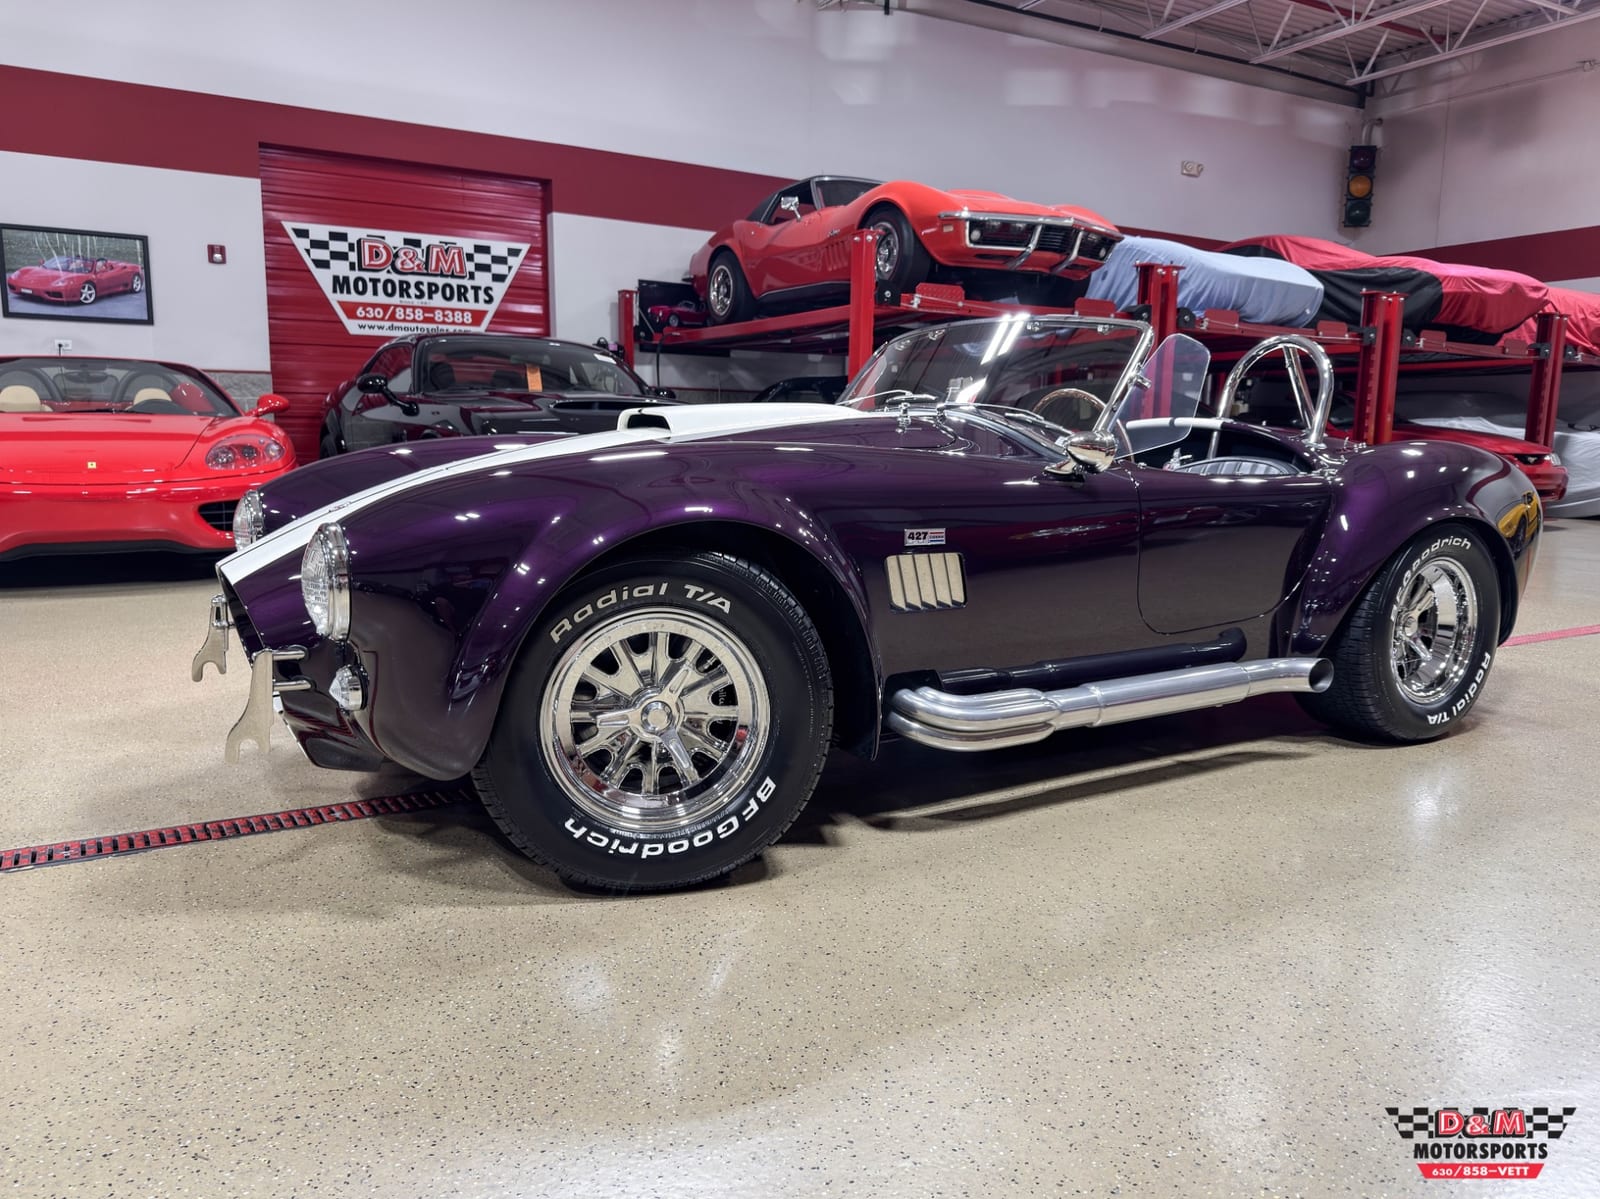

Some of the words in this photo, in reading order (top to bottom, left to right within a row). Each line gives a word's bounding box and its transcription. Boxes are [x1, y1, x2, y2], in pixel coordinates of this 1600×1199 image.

[358, 238, 467, 278] D&M
[332, 275, 494, 305] MOTORSPORTS
[356, 306, 473, 324] 630/858-8388
[357, 323, 472, 335] www.dmautosales
[908, 531, 928, 541] 427
[550, 582, 669, 644] Radial
[684, 583, 732, 614] T/A
[1452, 652, 1491, 716] Radial
[1427, 711, 1450, 725] T/A
[564, 776, 777, 859] BFGoodrich
